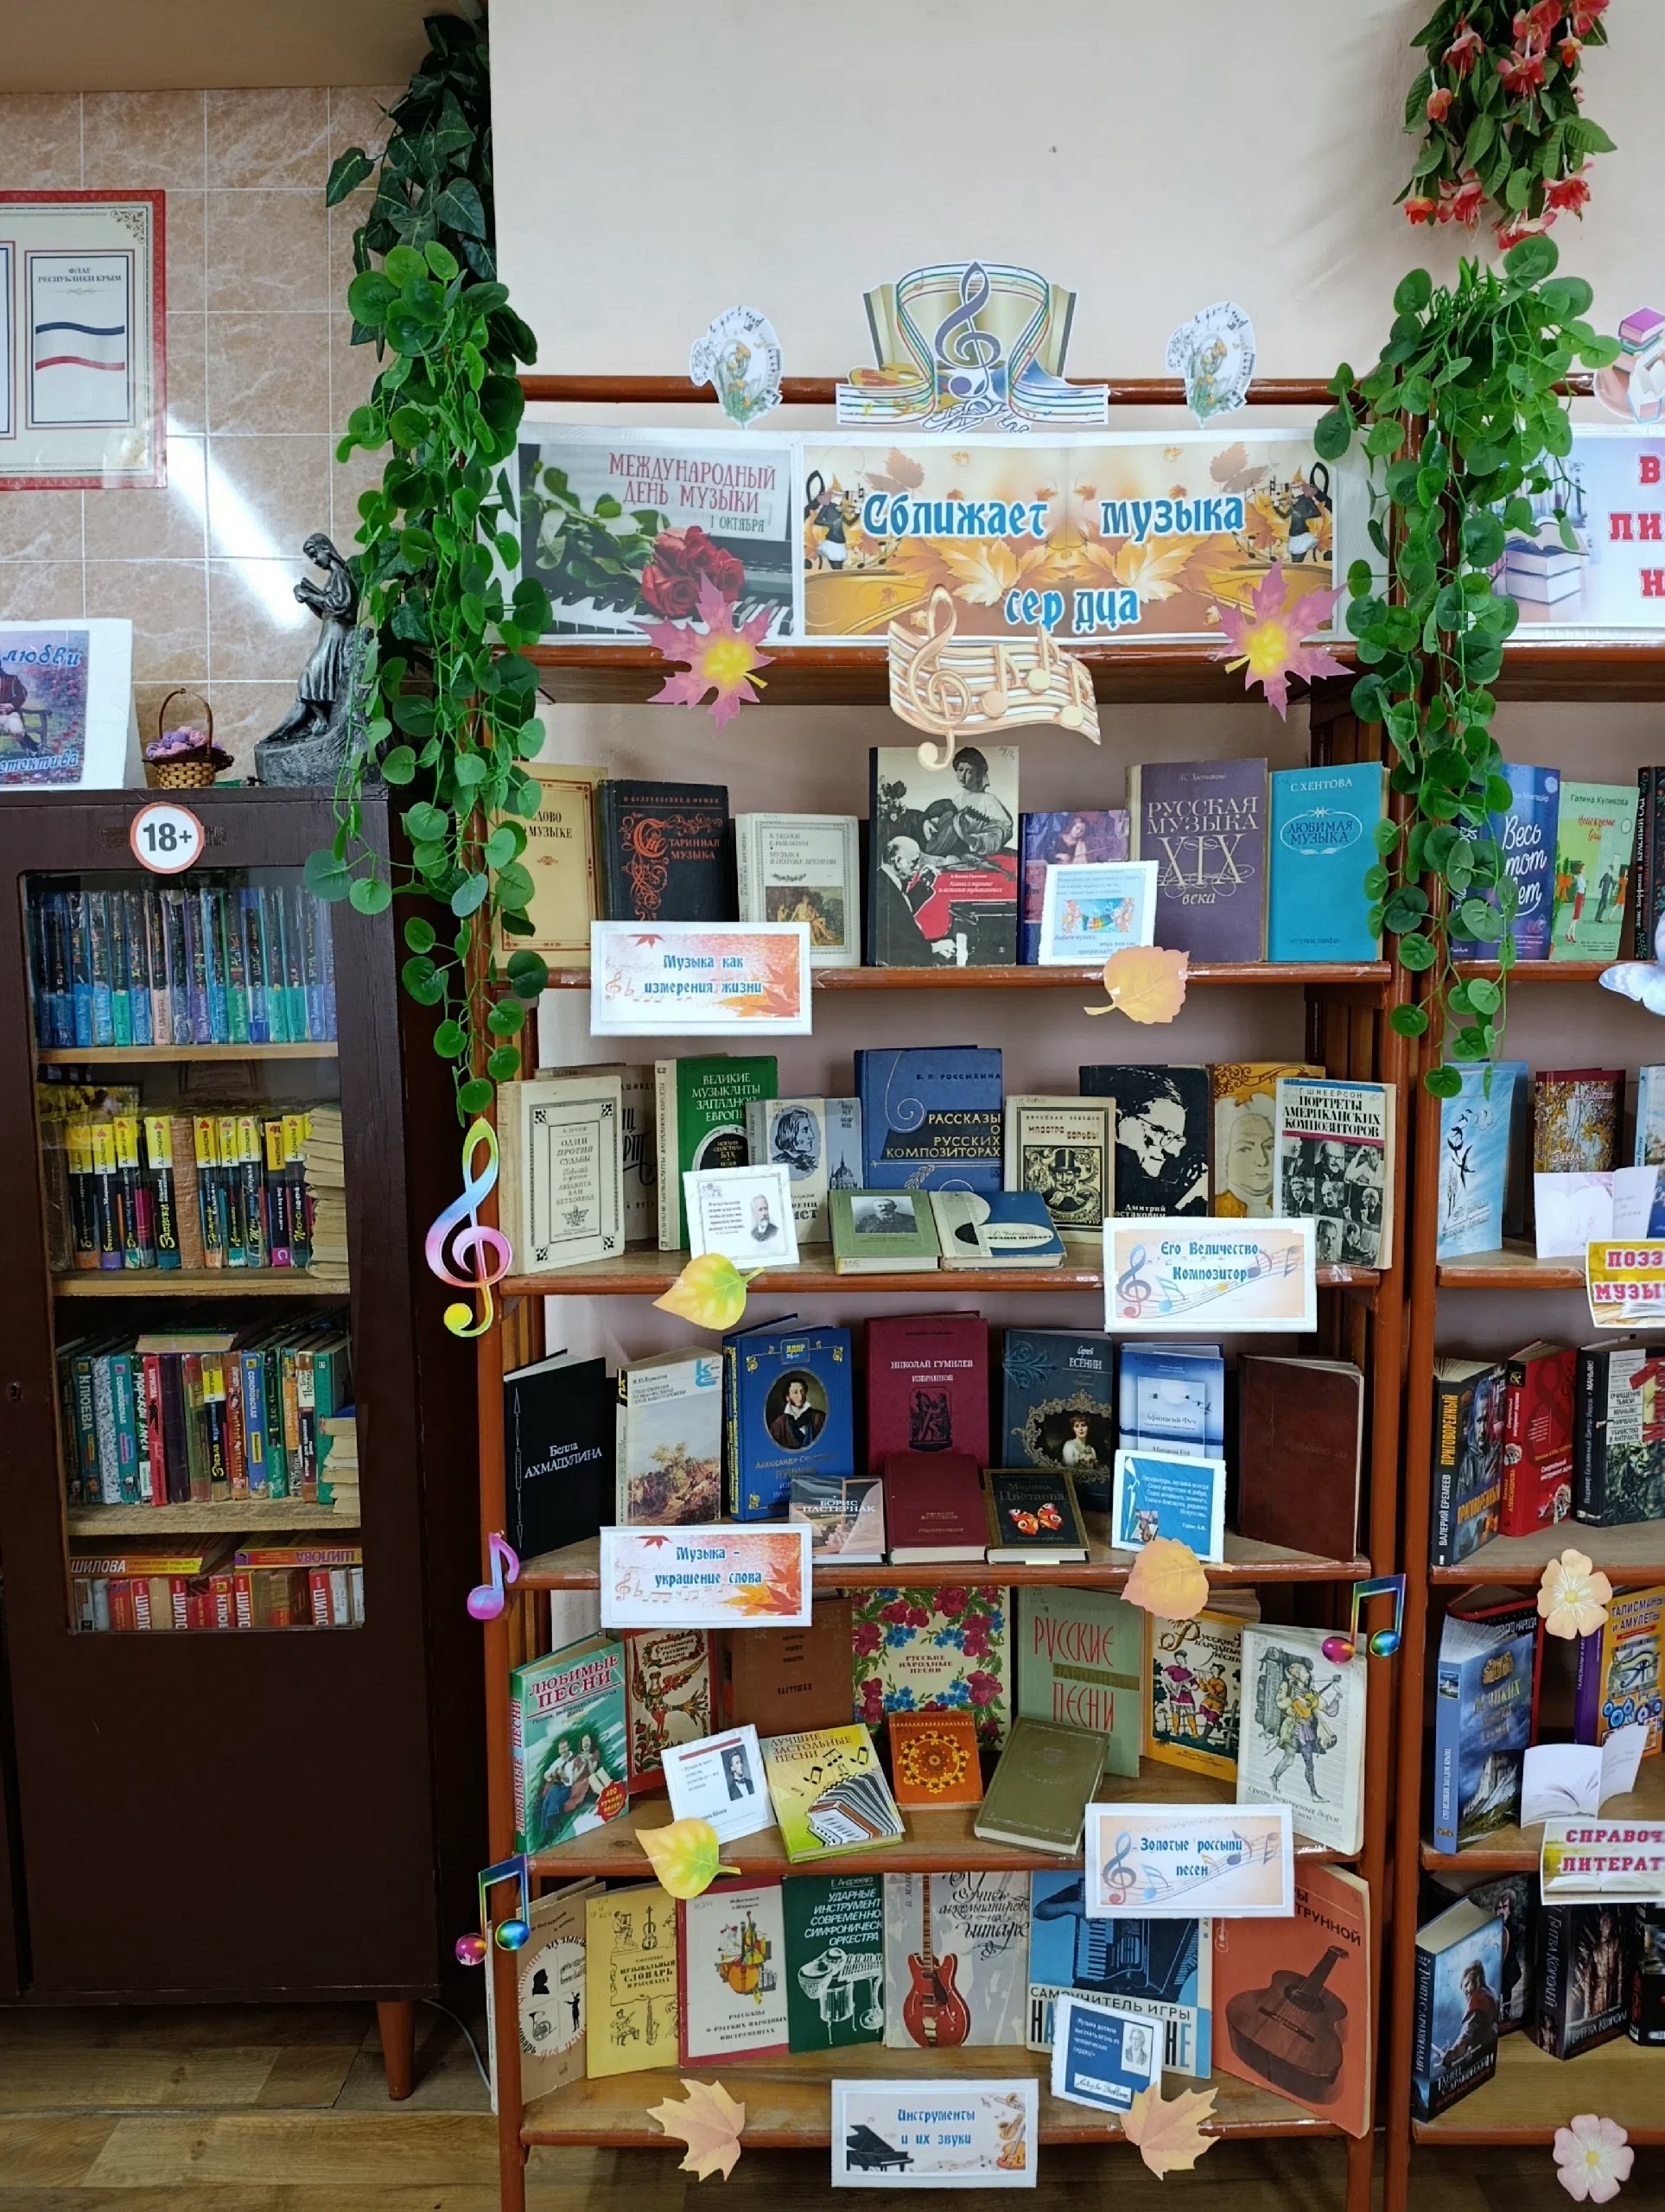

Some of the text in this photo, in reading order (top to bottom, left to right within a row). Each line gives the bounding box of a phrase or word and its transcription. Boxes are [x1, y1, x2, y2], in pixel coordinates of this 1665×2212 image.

[609, 452, 777, 491] МЕЖДУНАРОДНЫЙ
[623, 480, 759, 514] ДЕНЬ МУЗЫКИ
[709, 516, 765, 532] 1 ОКТЯБРЯ
[864, 494, 1243, 542] Сближает музыка
[3, 645, 81, 665] любви
[0, 751, 78, 773] етектива
[1300, 779, 1353, 791] ХЕНТОВА
[1571, 794, 1628, 805] Галина Куликова
[1147, 797, 1258, 818] РУССКАЯ
[532, 812, 562, 823] ЛОВО
[1147, 814, 1258, 835] МУЗЫКА
[529, 827, 572, 838] МУЗЫКЕ
[1287, 820, 1353, 834] ЛЮБИМАЯ
[1502, 816, 1541, 850] Весь
[143, 823, 192, 851] 18+
[1290, 831, 1349, 845] МУЗЫКА
[670, 851, 715, 860] МУЗЫКА
[1158, 833, 1246, 887] XIX
[1505, 849, 1547, 876] тот
[1182, 892, 1215, 905] века
[664, 955, 742, 970] Музыка как
[645, 982, 761, 995] измерения жизни
[703, 1073, 750, 1084] ВЕЛИКИЕ
[691, 1084, 760, 1097] МУЗЫКАНТЫ
[1307, 1089, 1363, 1098] ШНЕЕРСОН
[1299, 1096, 1362, 1110] ПОРТРЕТЫ
[928, 1114, 1001, 1124] РАССКАЗЫ
[1282, 1107, 1381, 1124] АМЕРИКАНСКИХ
[991, 1126, 1000, 1135] О
[1285, 1118, 1379, 1137] КОМПОЗИТОРОВ
[561, 1137, 588, 1147] ОДИН
[934, 1136, 1001, 1147] РУССКИХ
[557, 1146, 594, 1156] ПРОТИВ
[887, 1147, 1001, 1158] КОМПОЗИТОРАХ
[560, 1155, 590, 1165] СУДЬБЫ
[558, 1181, 591, 1191] ЛЮДВИГА
[556, 1194, 594, 1205] БЕТХОВЕНА
[793, 1210, 819, 1220] ИСТ
[1125, 1204, 1166, 1212] Дмитрий
[1161, 1242, 1258, 1255] Его Величество
[1172, 1266, 1247, 1282] Композитор
[1595, 1284, 1665, 1300] МУЗЫ
[891, 1358, 973, 1369] НИКОЛАЙ ГУМИЛЕВ
[1069, 1357, 1102, 1370] ЕСЕНИН
[79, 1376, 92, 1430] КЛЮЕВА
[1441, 1395, 1458, 1465] ПРИГОВОРЕННЫЙ
[550, 1442, 578, 1457] Белла
[524, 1447, 602, 1478] АХМАДУЛИНА
[1439, 1474, 1451, 1546] ВАЛЕРИЙ ЕРЕМЕЕВ
[296, 1550, 354, 1564] ШИЛОВА
[677, 1547, 725, 1562] Музыка
[72, 1560, 126, 1573] ШИЛОВА
[655, 1573, 761, 1587] украшение слова
[136, 1594, 150, 1630] ШИЛО
[174, 1592, 187, 1629] ШИЛО
[218, 1594, 228, 1628] КЛЮЕ
[236, 1592, 251, 1627] ШИЛО
[314, 1589, 328, 1625] ШИЛО
[1620, 1612, 1661, 1630] АМУЛЕТЫ
[1034, 1615, 1114, 1667] РУССКИЕ
[529, 1654, 619, 1696] ЛЮБИМЫЕ
[538, 1669, 611, 1708] ПЕСНИ
[1052, 1682, 1114, 1732] ПЕСНИ
[770, 1732, 821, 1746] ЛУЧШИЕ
[772, 1736, 852, 1754] ЗАСТОЛЬНЫЕ
[775, 1751, 818, 1763] ПЕСНИ
[513, 1700, 524, 1835] ЛЮБИМЫЕ ПЕСНИ
[1566, 1829, 1663, 1842] СПРАВОЧ
[1141, 1837, 1242, 1853] Золотые россыпи
[1176, 1866, 1208, 1876] песен
[1563, 1857, 1663, 1871] ЛИТЕРАТ
[838, 1877, 874, 1886] Андреева
[829, 1889, 876, 1902] УДАРНЫЕ
[814, 1899, 880, 1914] ИНСТРУМЕНТ
[810, 1910, 880, 1925] СОВРЕМЕННО
[804, 1923, 882, 1938] СИМФОНИЧЕСК
[829, 1933, 879, 1945] ОРКЕСТРА
[620, 1960, 675, 1974] МУЗЫКАЛЬНЫЙ
[624, 1968, 672, 1982] СЛОВАРЬ
[634, 1978, 670, 1987] РАССКАЗАХ
[729, 2010, 765, 2019] РАССКАЗЫ
[1147, 2005, 1191, 2020] ИГРЫ
[721, 2029, 775, 2040] ИНСТРУМЕНТАХ
[898, 2109, 975, 2123] Инструменты
[901, 2133, 971, 2146] и их звуки
